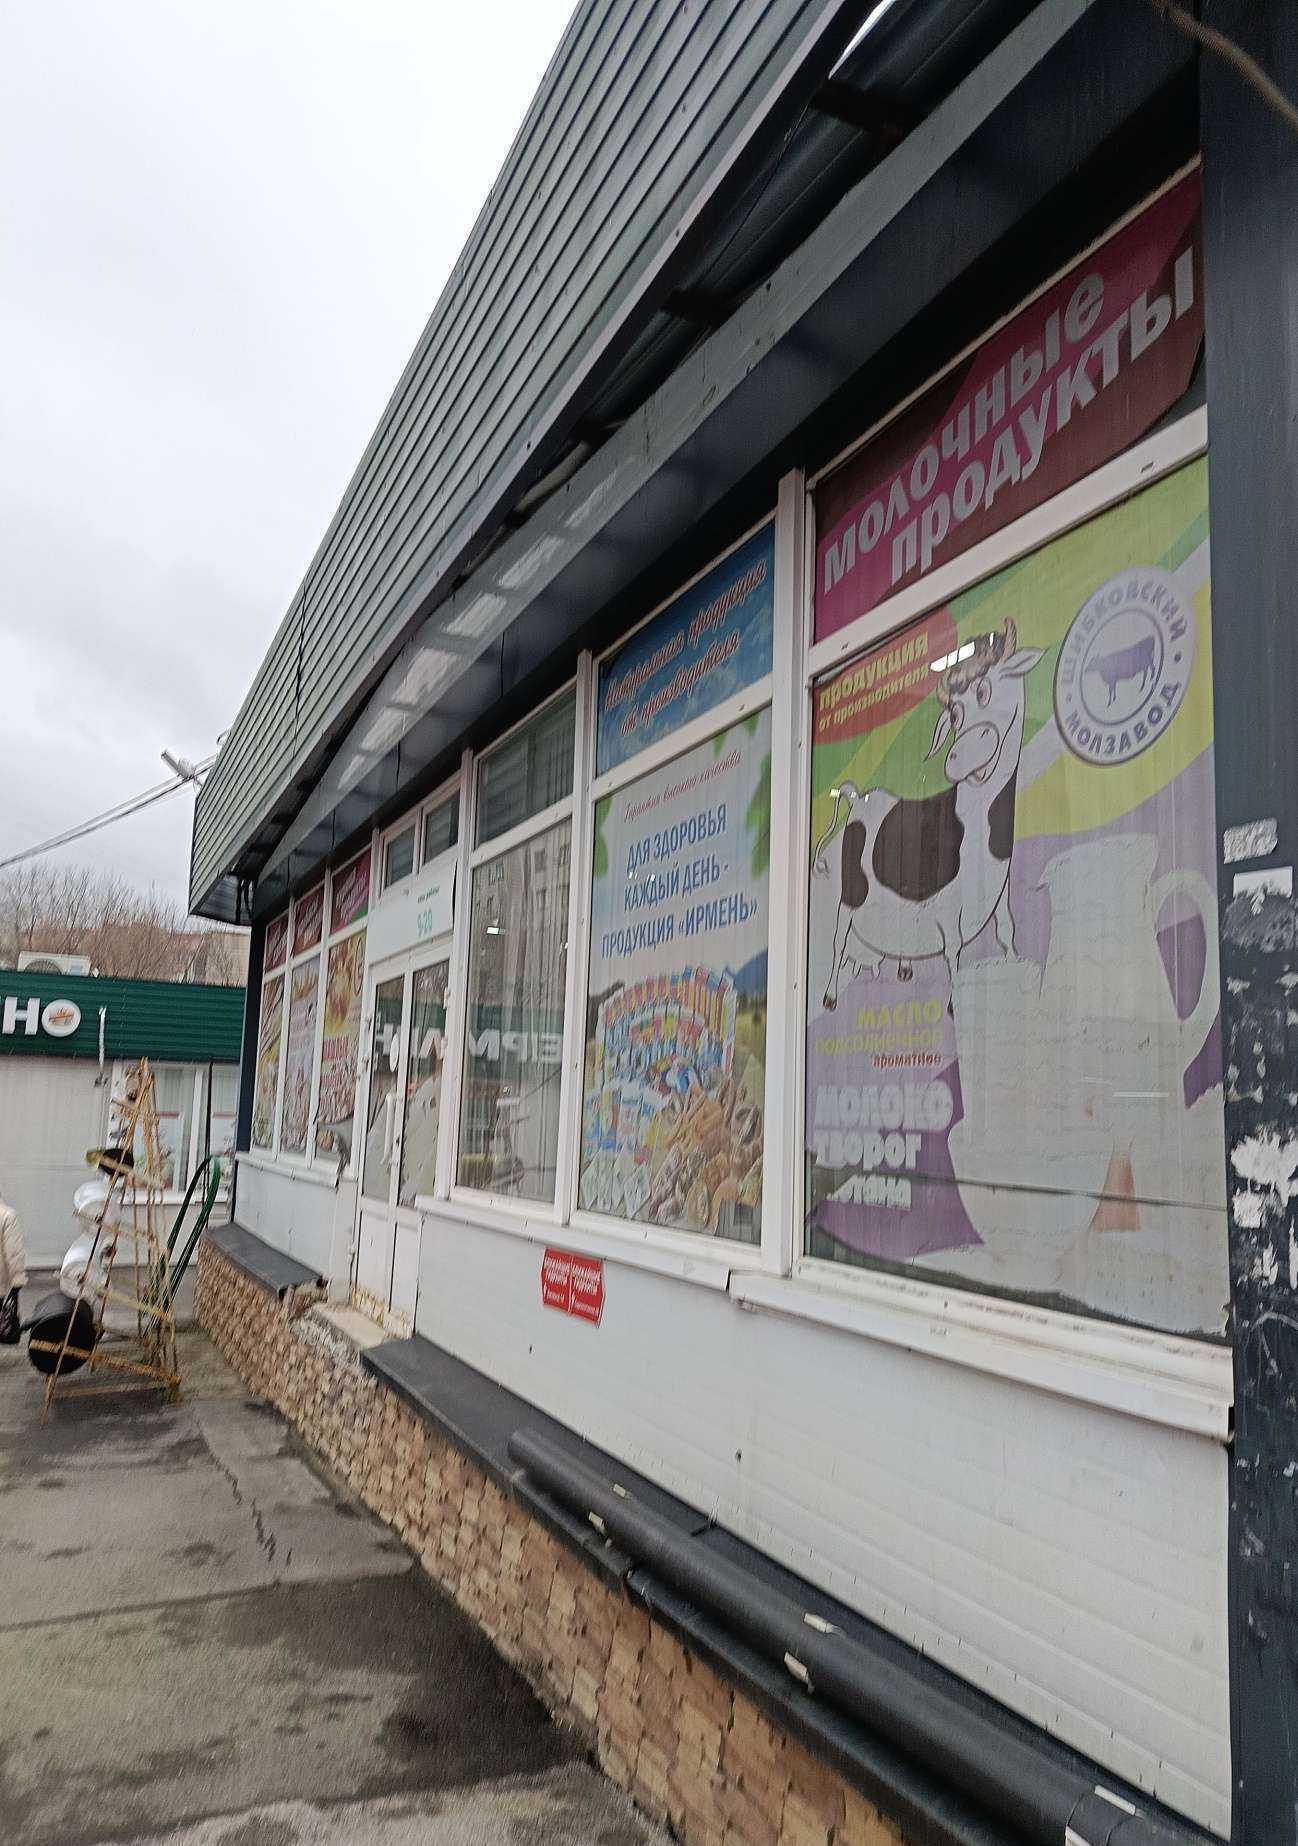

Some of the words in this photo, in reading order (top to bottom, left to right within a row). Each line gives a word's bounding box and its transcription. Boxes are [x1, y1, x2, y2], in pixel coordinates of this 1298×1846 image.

[604, 630, 685, 712] Натуральная
[687, 559, 768, 649] продукция
[621, 703, 639, 737] от
[640, 627, 741, 730] производителя
[1065, 681, 1182, 756] МОЛЗАВОД
[699, 749, 742, 784] качества
[626, 837, 650, 874] ДЛЯ
[654, 804, 726, 863] ЗДОРОВЬЯ
[624, 862, 679, 914] КАЖДЫЙ
[682, 854, 720, 899] ДЕНЬ
[601, 913, 675, 959] ПРОДУКЦИЯ
[678, 891, 758, 938] «ИРМЕНЬ»
